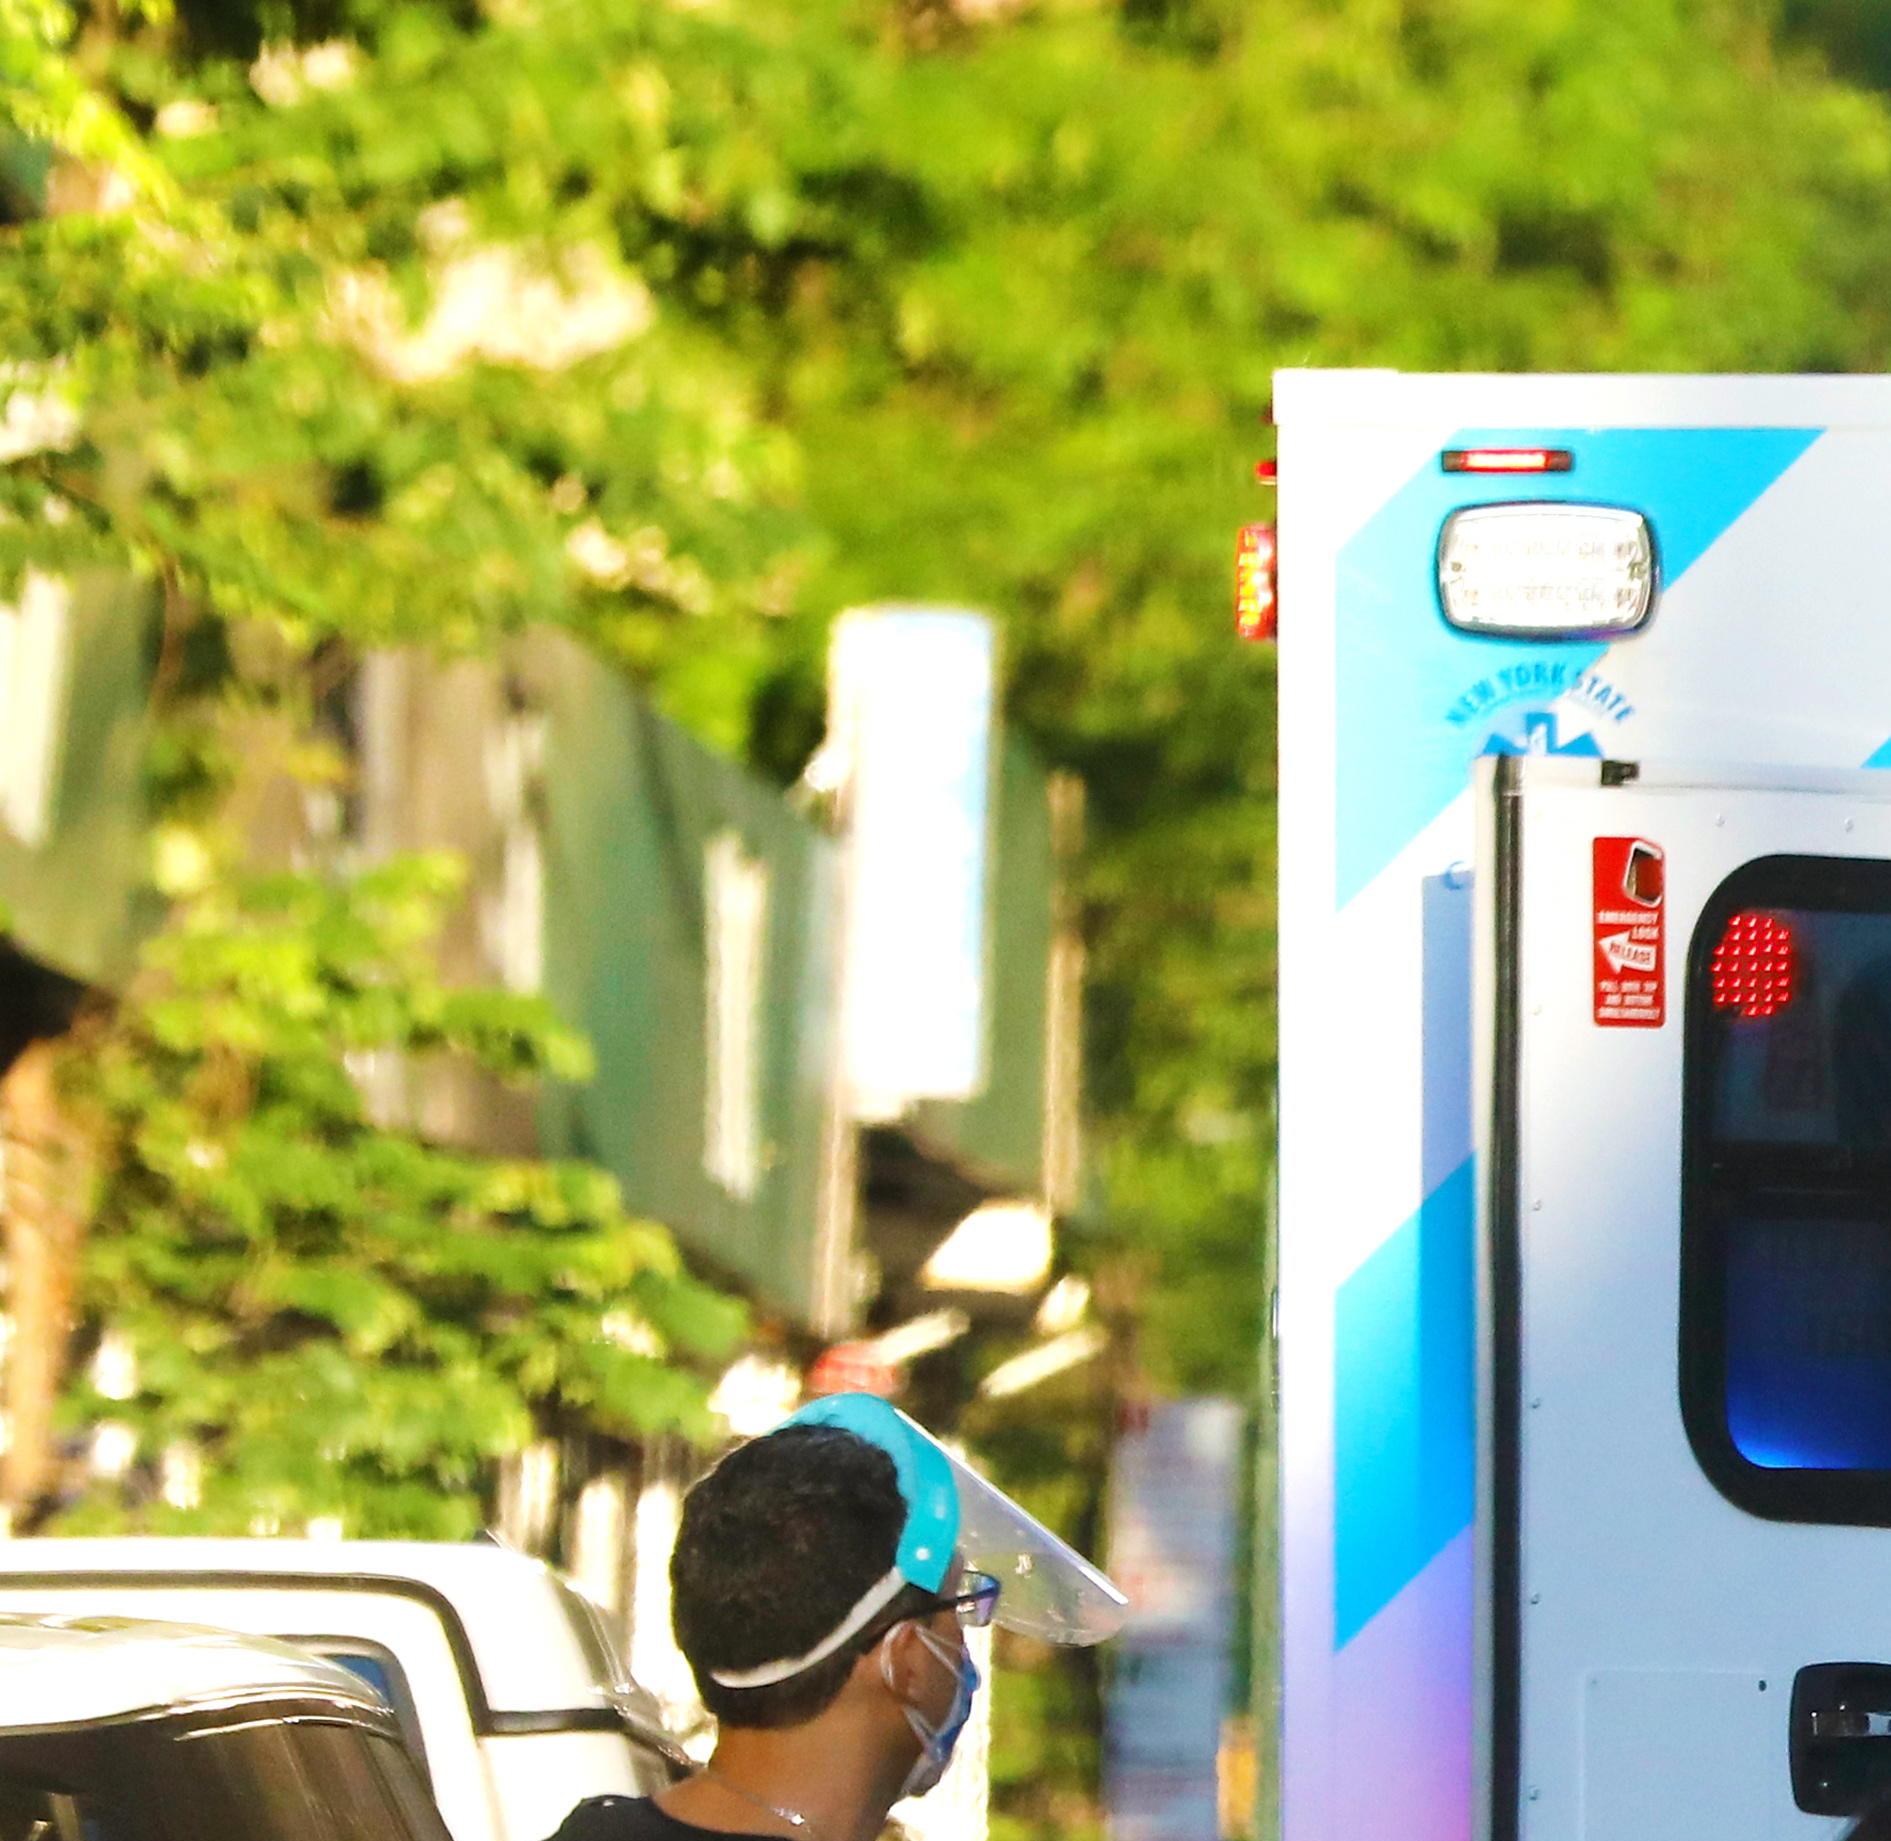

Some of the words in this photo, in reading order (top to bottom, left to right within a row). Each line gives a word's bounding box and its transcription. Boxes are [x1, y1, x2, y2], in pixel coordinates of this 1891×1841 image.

[1445, 678, 1496, 728] NEW
[1497, 662, 1566, 690] YORK
[1574, 670, 1635, 723] STATE
